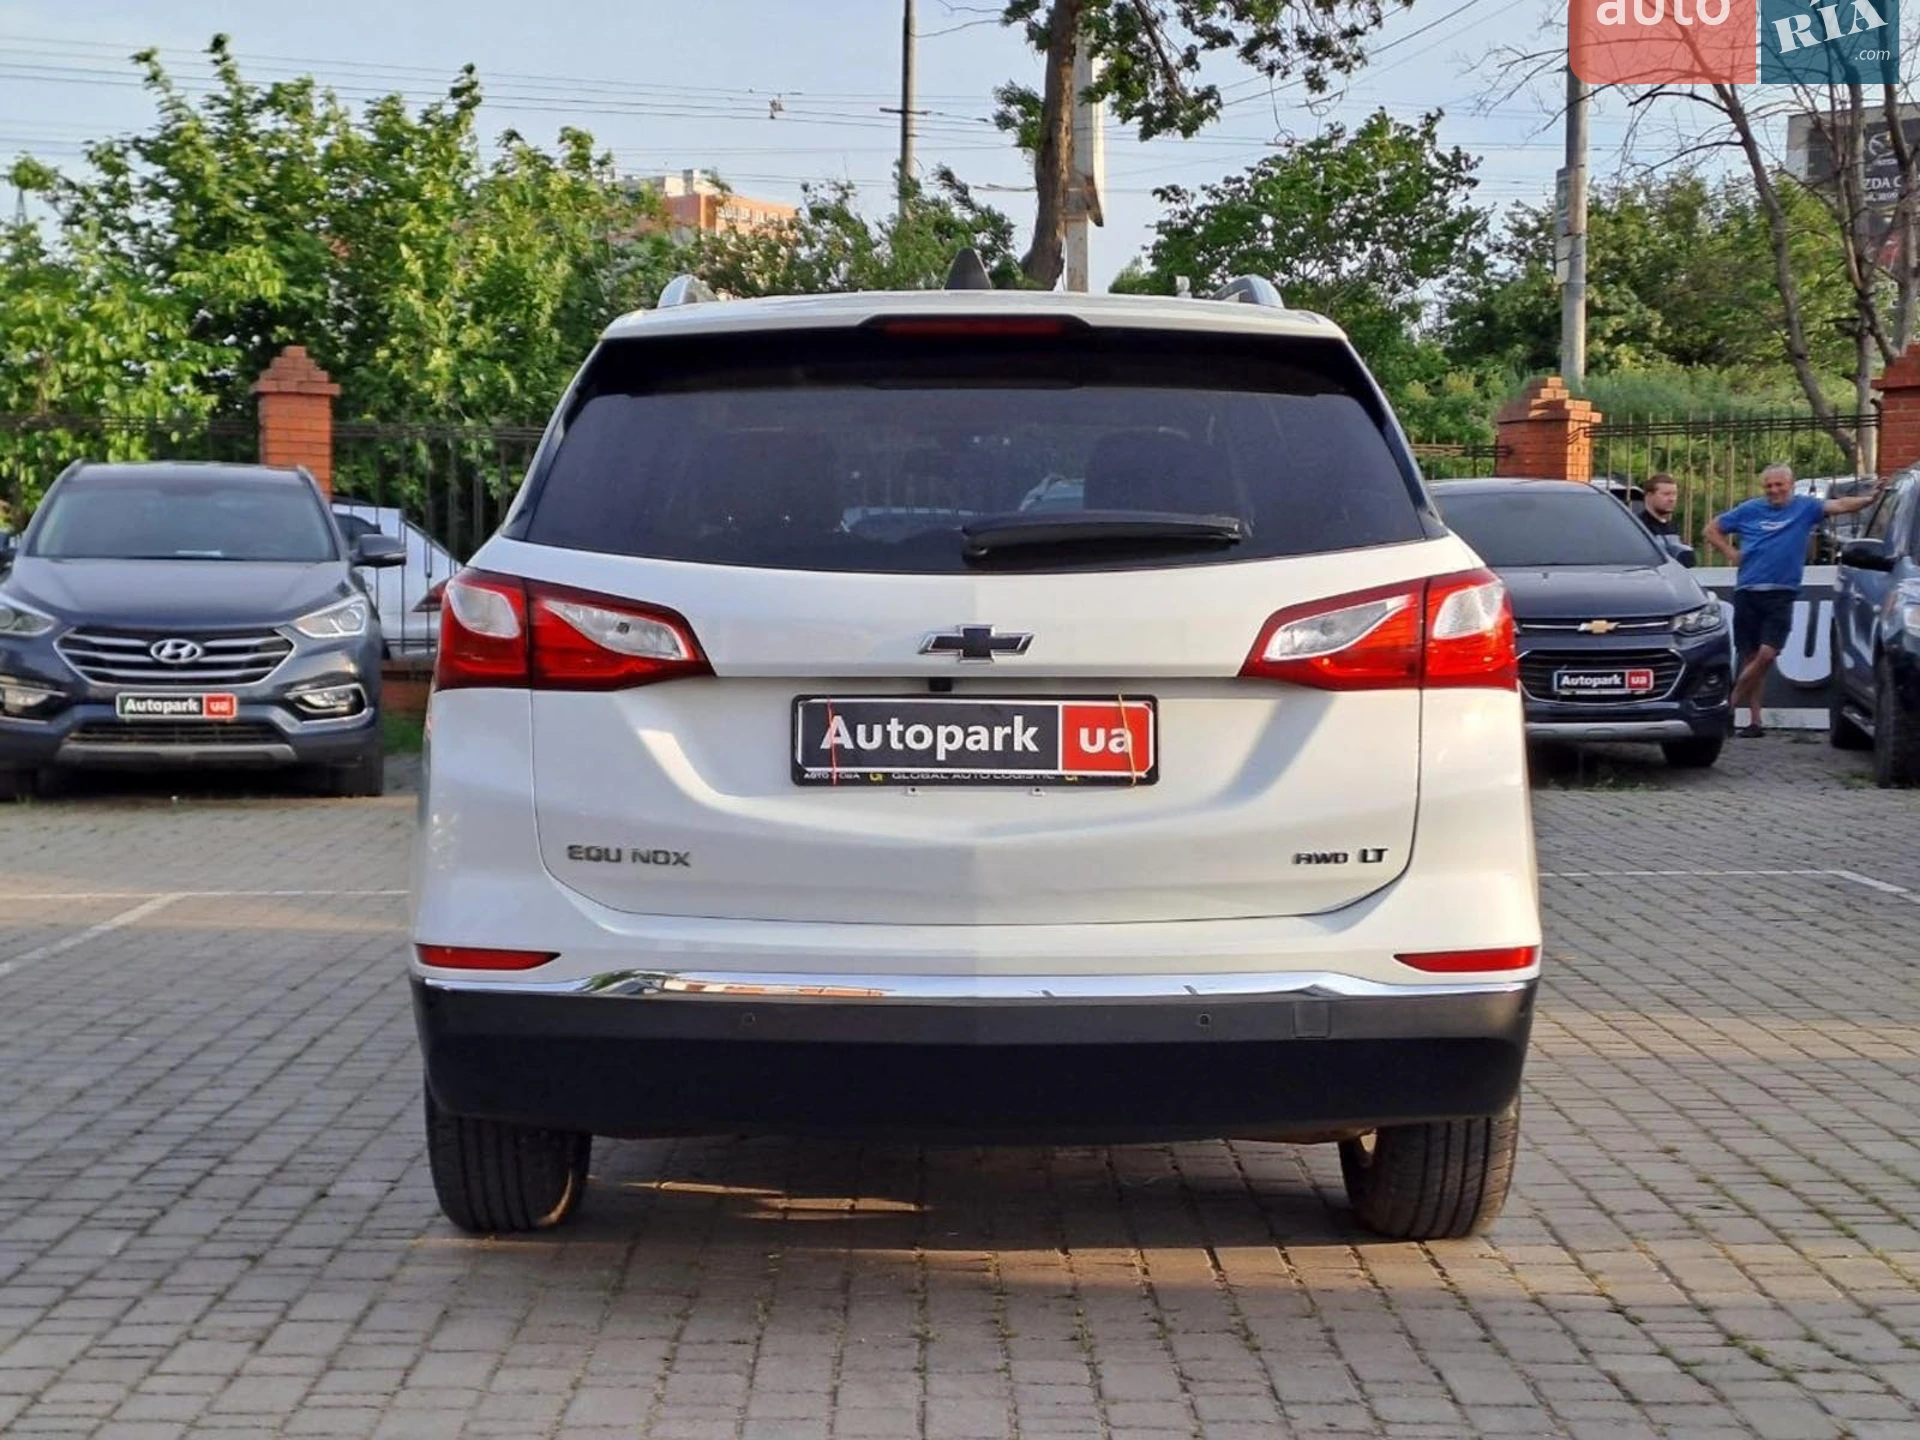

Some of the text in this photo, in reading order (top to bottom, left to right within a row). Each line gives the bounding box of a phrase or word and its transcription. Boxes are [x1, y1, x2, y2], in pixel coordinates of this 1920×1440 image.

[1560, 674, 1648, 688] Autopark ua
[124, 698, 231, 714] Autopark ua
[820, 714, 1133, 761] Autopark ua
[1292, 847, 1389, 864] AWD LT
